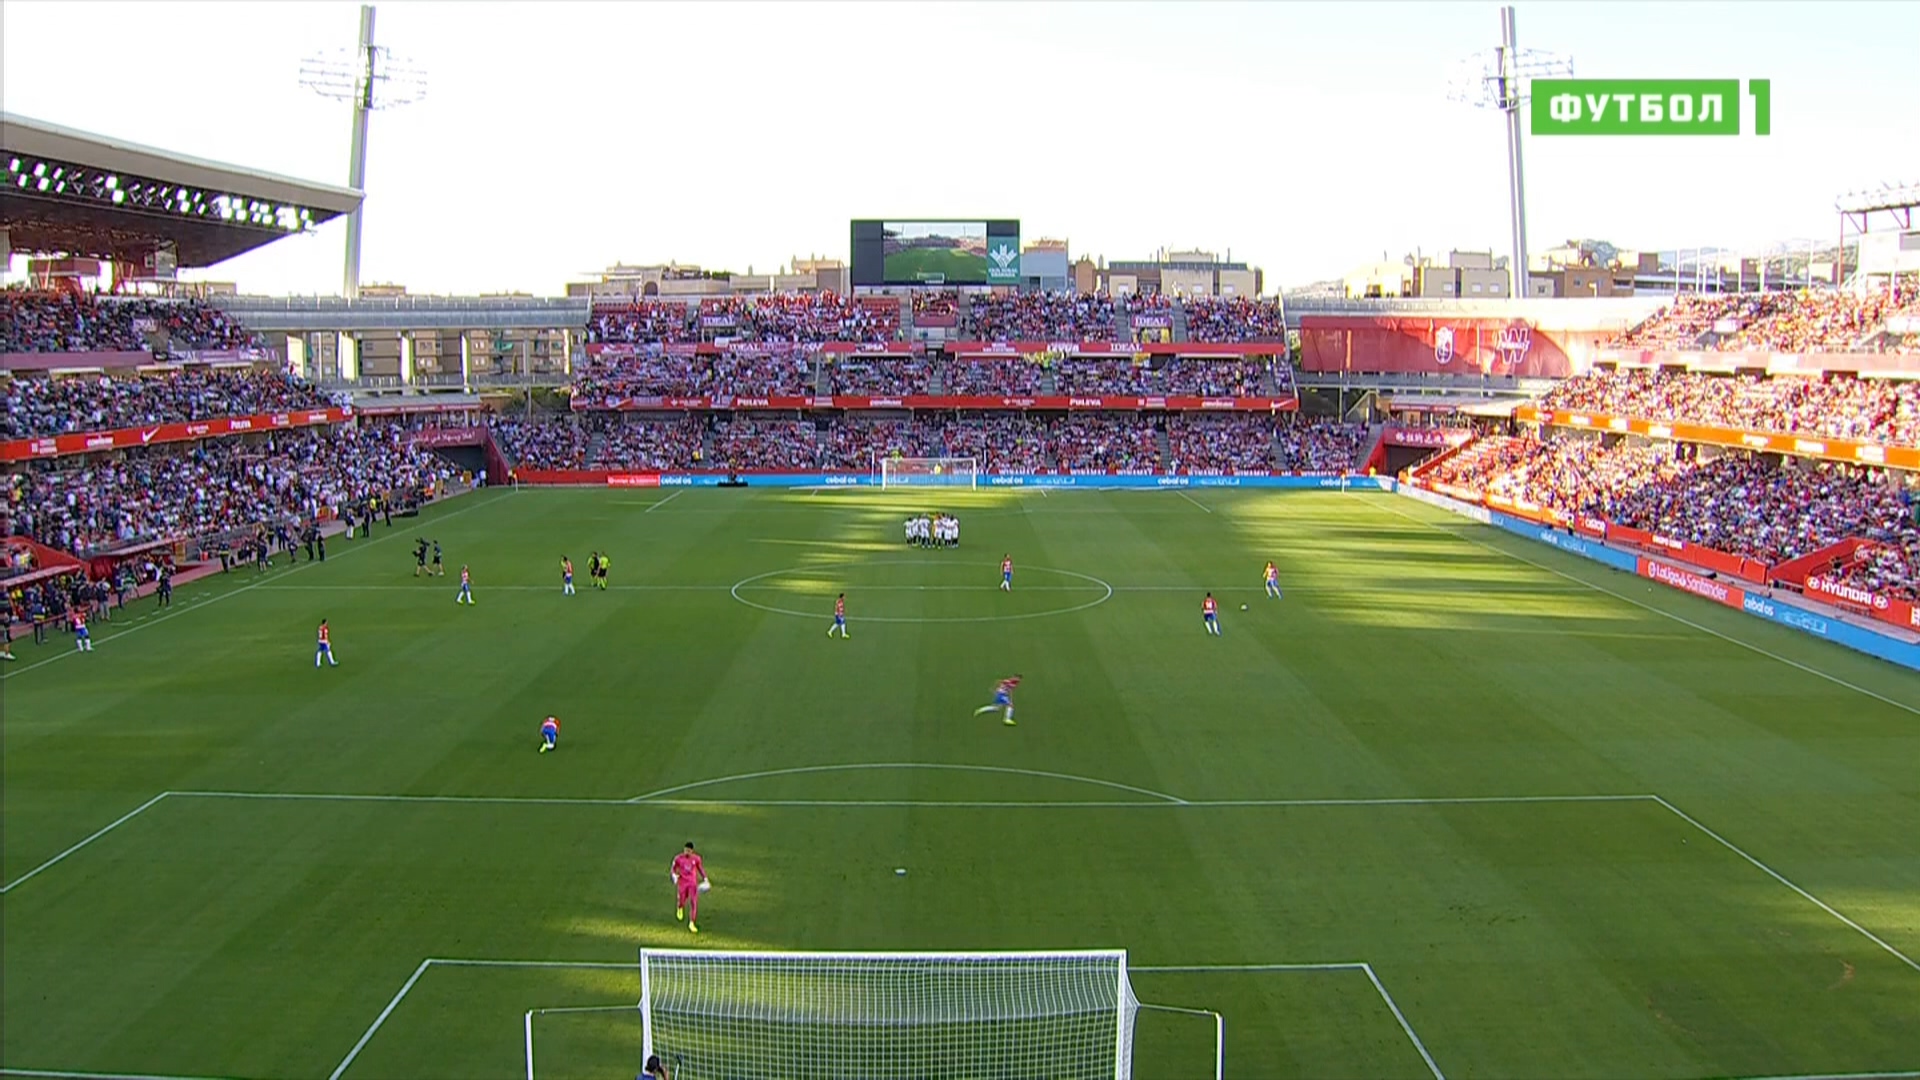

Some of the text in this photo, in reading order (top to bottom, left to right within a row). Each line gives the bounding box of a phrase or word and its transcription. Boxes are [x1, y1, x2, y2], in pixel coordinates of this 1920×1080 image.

[1134, 317, 1167, 327] IDEAL
[1110, 343, 1142, 352] IDEAL
[1657, 563, 1728, 601] LaLiga Santander
